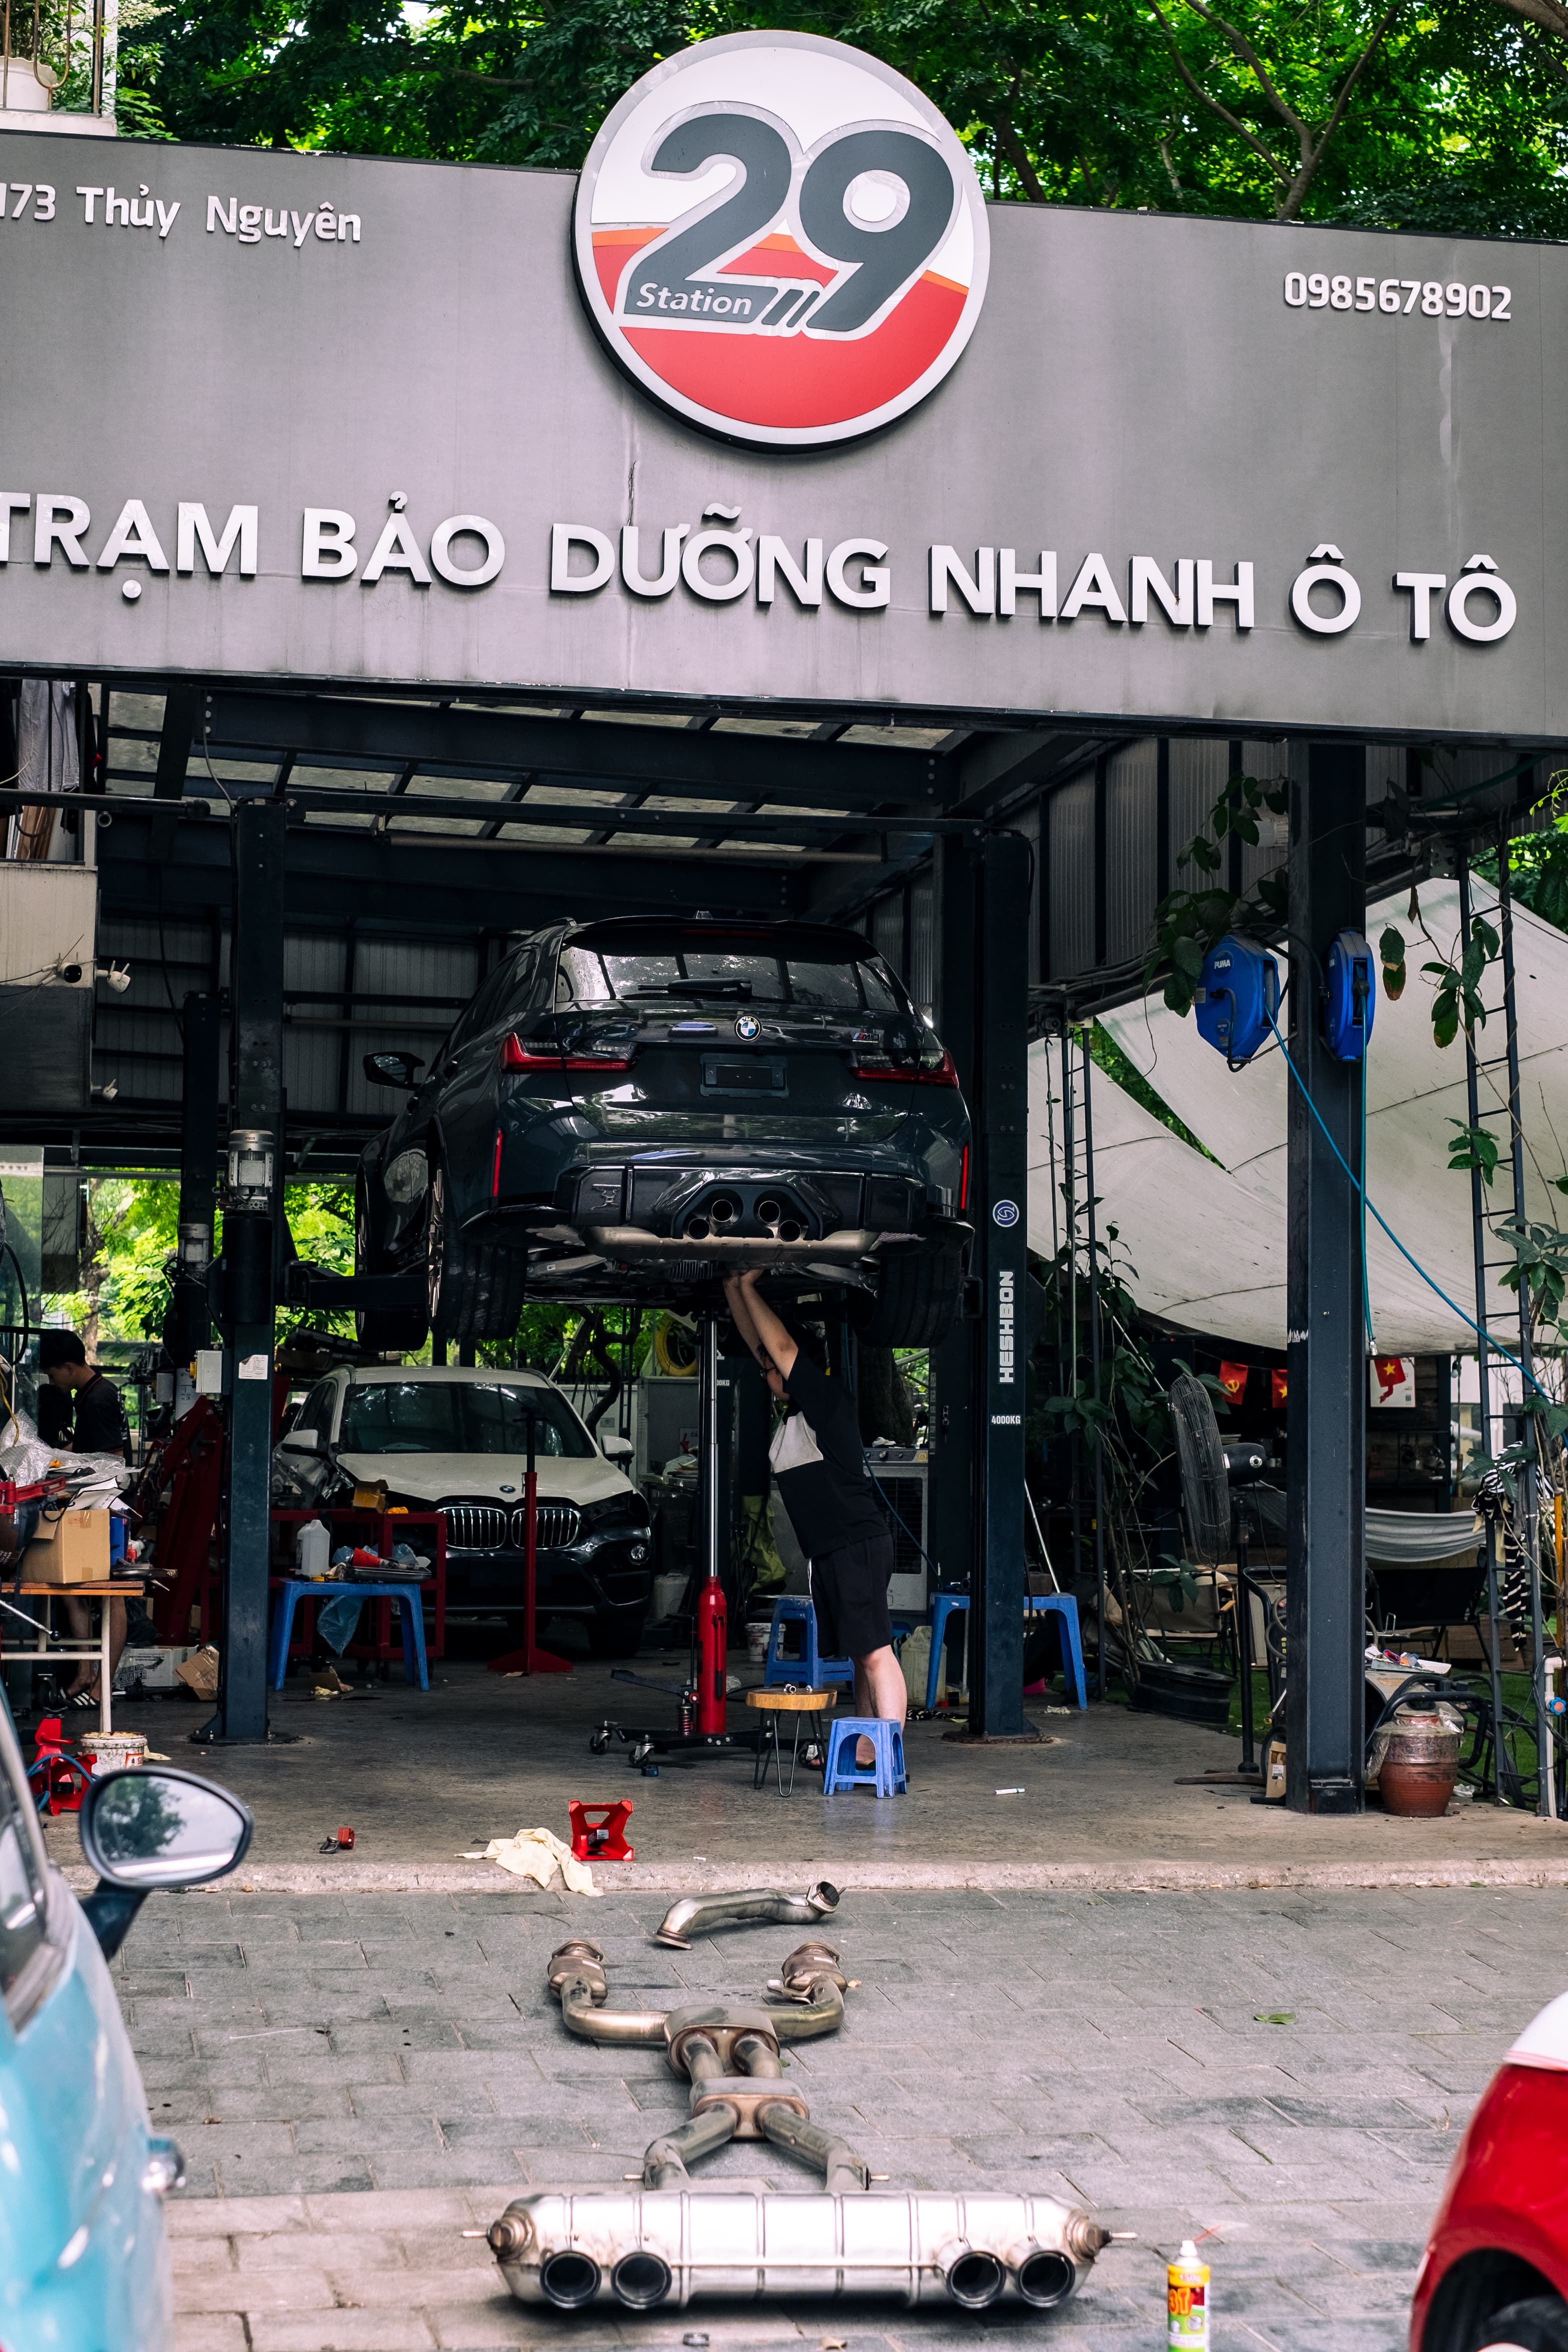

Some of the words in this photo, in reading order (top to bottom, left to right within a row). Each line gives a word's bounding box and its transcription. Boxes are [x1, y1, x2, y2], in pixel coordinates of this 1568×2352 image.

[76, 183, 181, 238] Thủy
[206, 195, 361, 247] Nguyên
[624, 113, 954, 331] 29
[635, 282, 752, 315] Station
[1284, 272, 1512, 320] 0985678902
[302, 491, 505, 587] BẢO
[549, 502, 891, 608] DƯỠNG
[928, 544, 1254, 629] NHANH
[1289, 543, 1361, 635] Ô
[1393, 554, 1517, 642] TÔ
[1214, 959, 1231, 969] PUMA
[1000, 1271, 1014, 1383] HESHBON
[991, 1415, 1021, 1425] 4000KG
